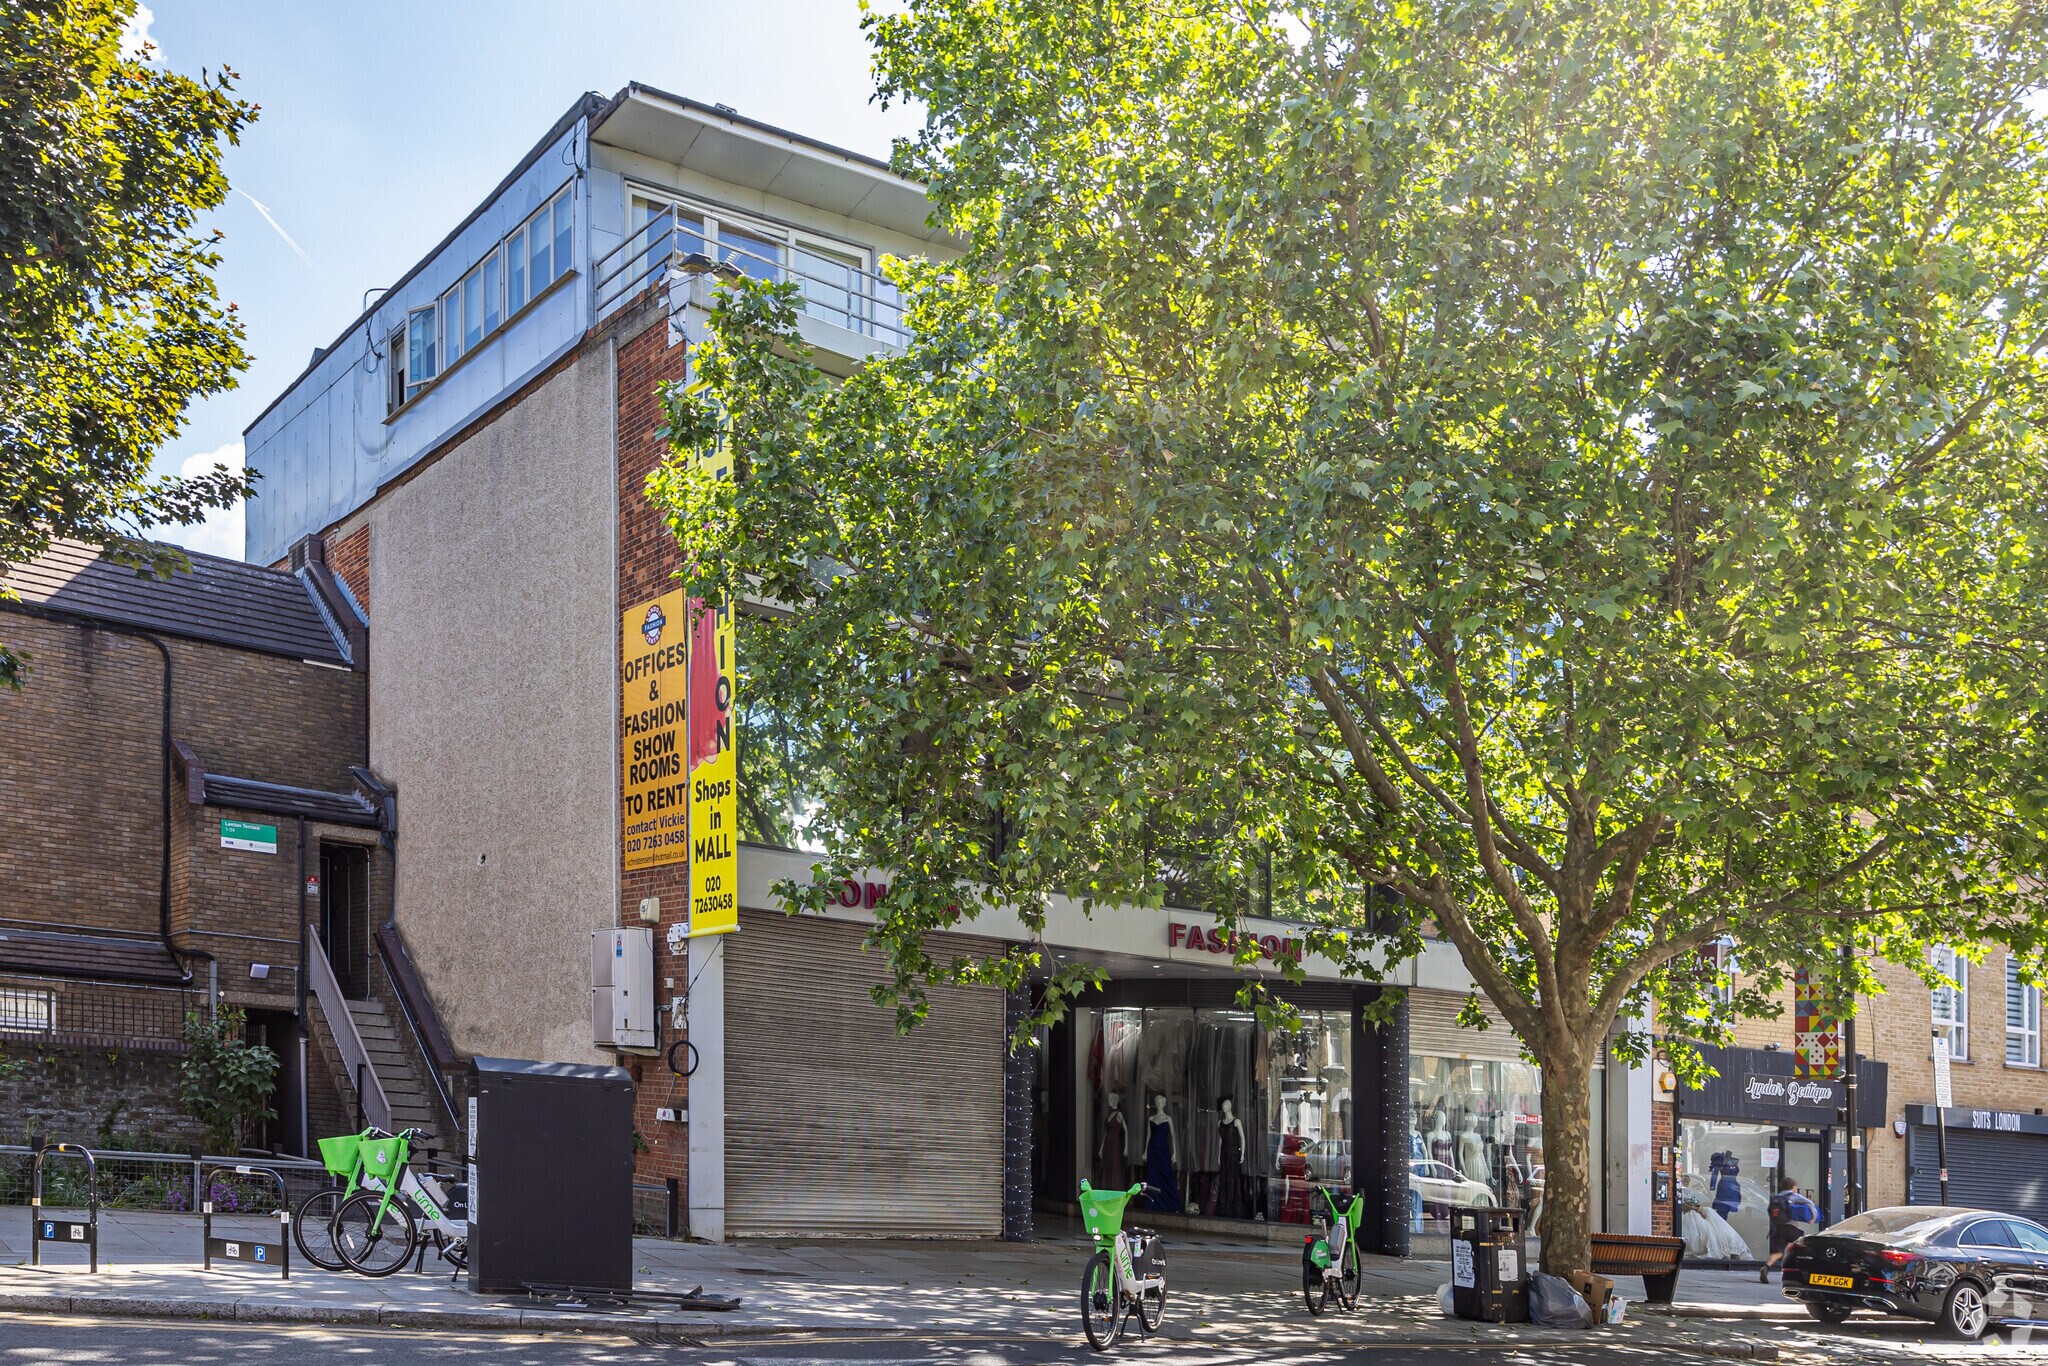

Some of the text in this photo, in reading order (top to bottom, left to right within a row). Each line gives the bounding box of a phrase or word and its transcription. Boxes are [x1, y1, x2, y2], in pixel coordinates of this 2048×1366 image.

[644, 619, 664, 631] FASHION
[624, 642, 685, 683] OFFICES
[649, 679, 659, 701] &
[624, 699, 686, 737] FASHION
[633, 730, 676, 761] SHOW
[629, 752, 681, 786] ROOMS
[625, 783, 686, 816] TO RENT
[695, 779, 731, 804] Shops
[626, 812, 685, 836] contact Vickie
[709, 805, 721, 830] in
[627, 830, 685, 853] 020 7263 0458
[695, 833, 732, 863] MALL
[705, 875, 721, 892] 020
[694, 893, 733, 914] 72630458
[1787, 1081, 1833, 1106] Boutique
[1972, 1110, 2021, 1132] SUITS LONDON
[413, 1188, 441, 1221] Lime
[1120, 1247, 1133, 1279] Lime
[1811, 1274, 1849, 1287] LP74 GGK
